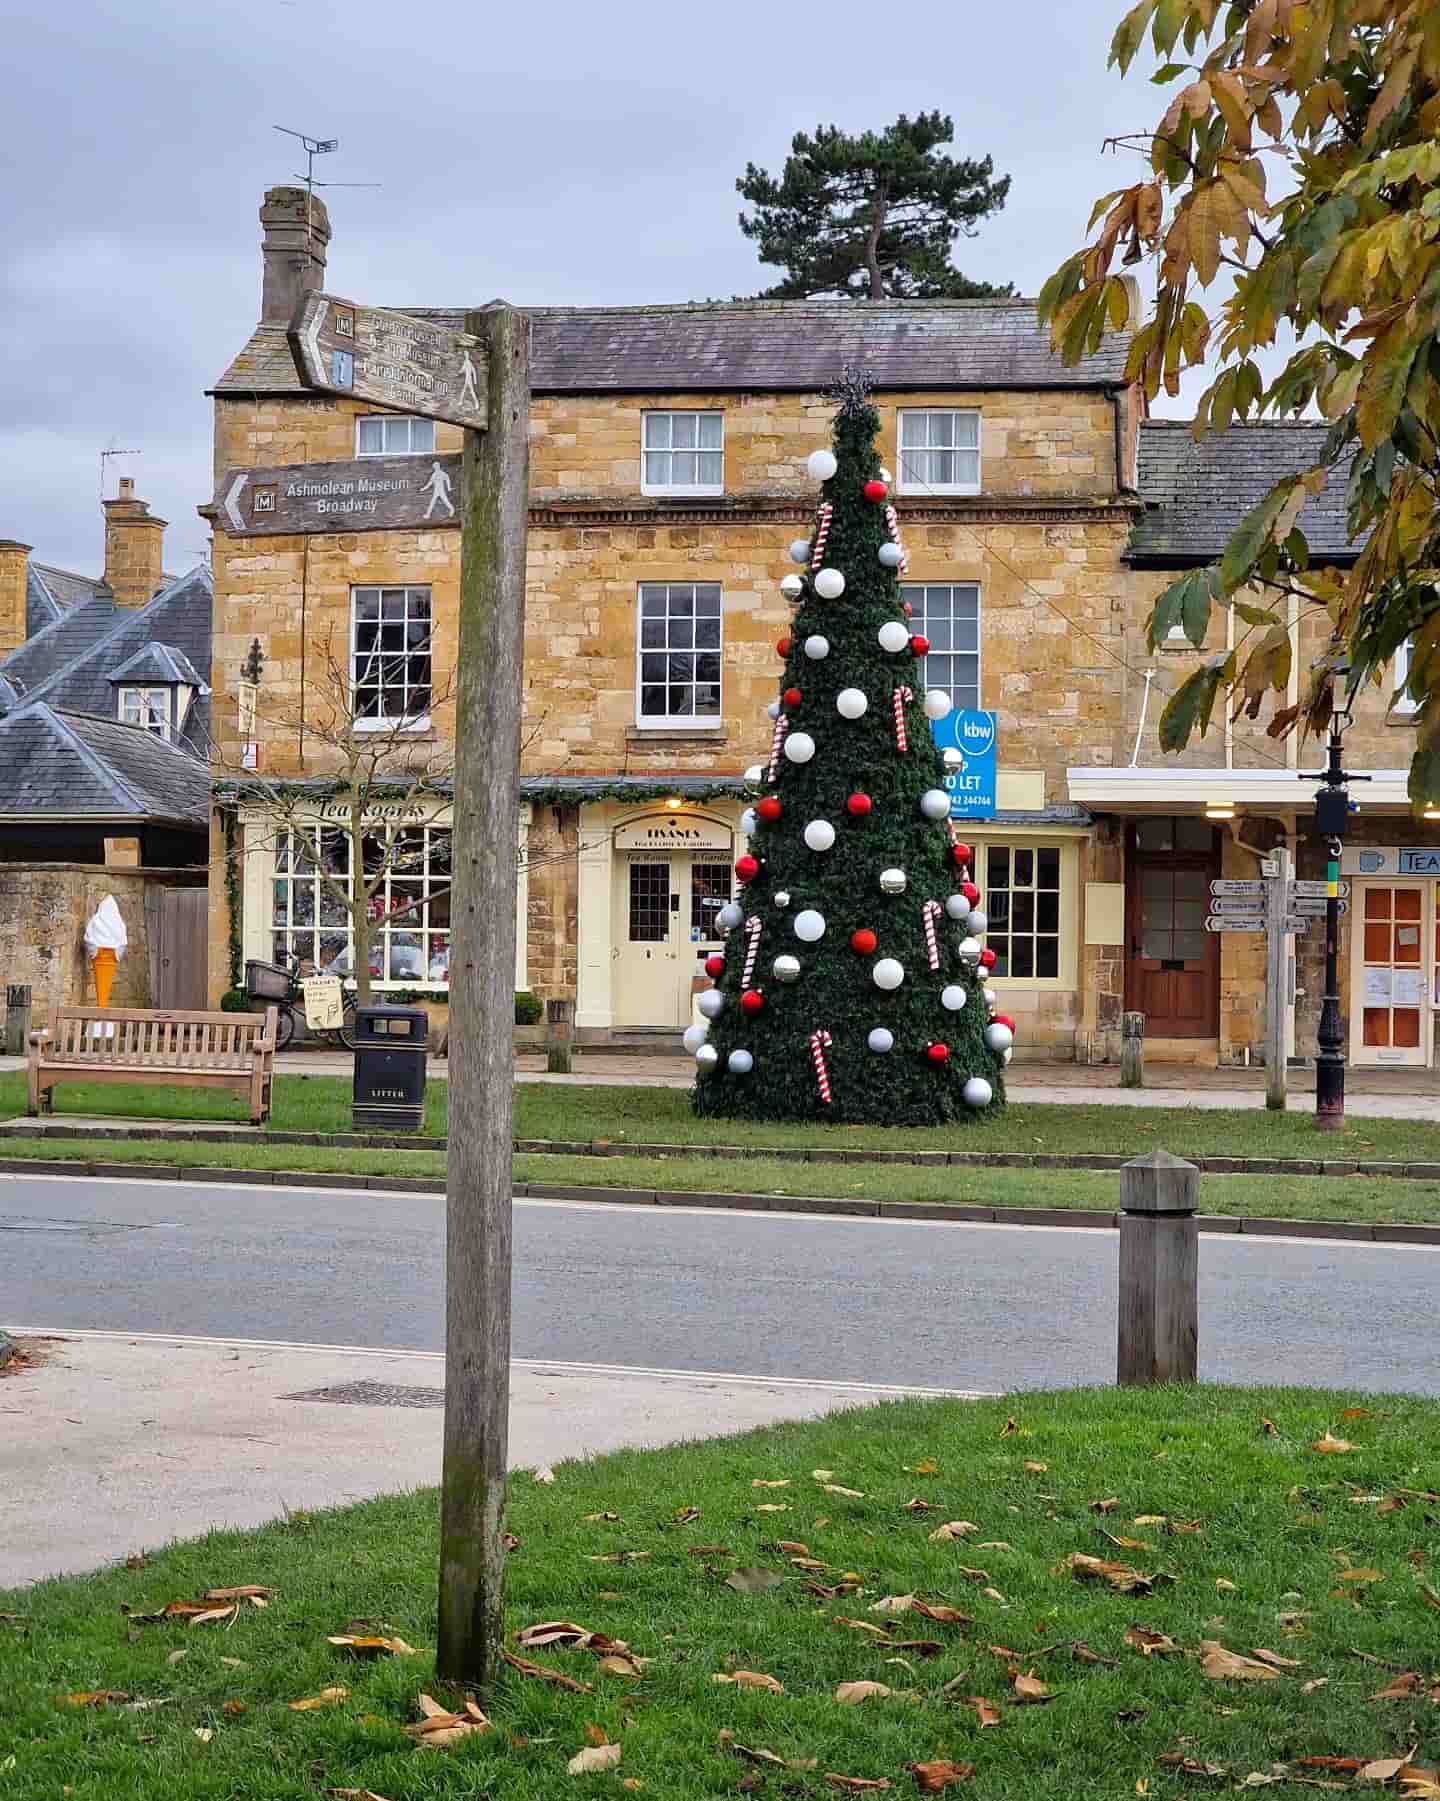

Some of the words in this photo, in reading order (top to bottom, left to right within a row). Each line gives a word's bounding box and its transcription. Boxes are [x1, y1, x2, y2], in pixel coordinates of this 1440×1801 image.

[287, 481, 354, 497] Ashmolean
[358, 478, 409, 493] Museum
[317, 498, 378, 514] Broadway
[964, 721, 991, 739] kbw
[959, 775, 981, 791] LET
[318, 801, 349, 818] Tea
[648, 829, 701, 839] TISANES
[371, 1089, 405, 1098] LITTER
